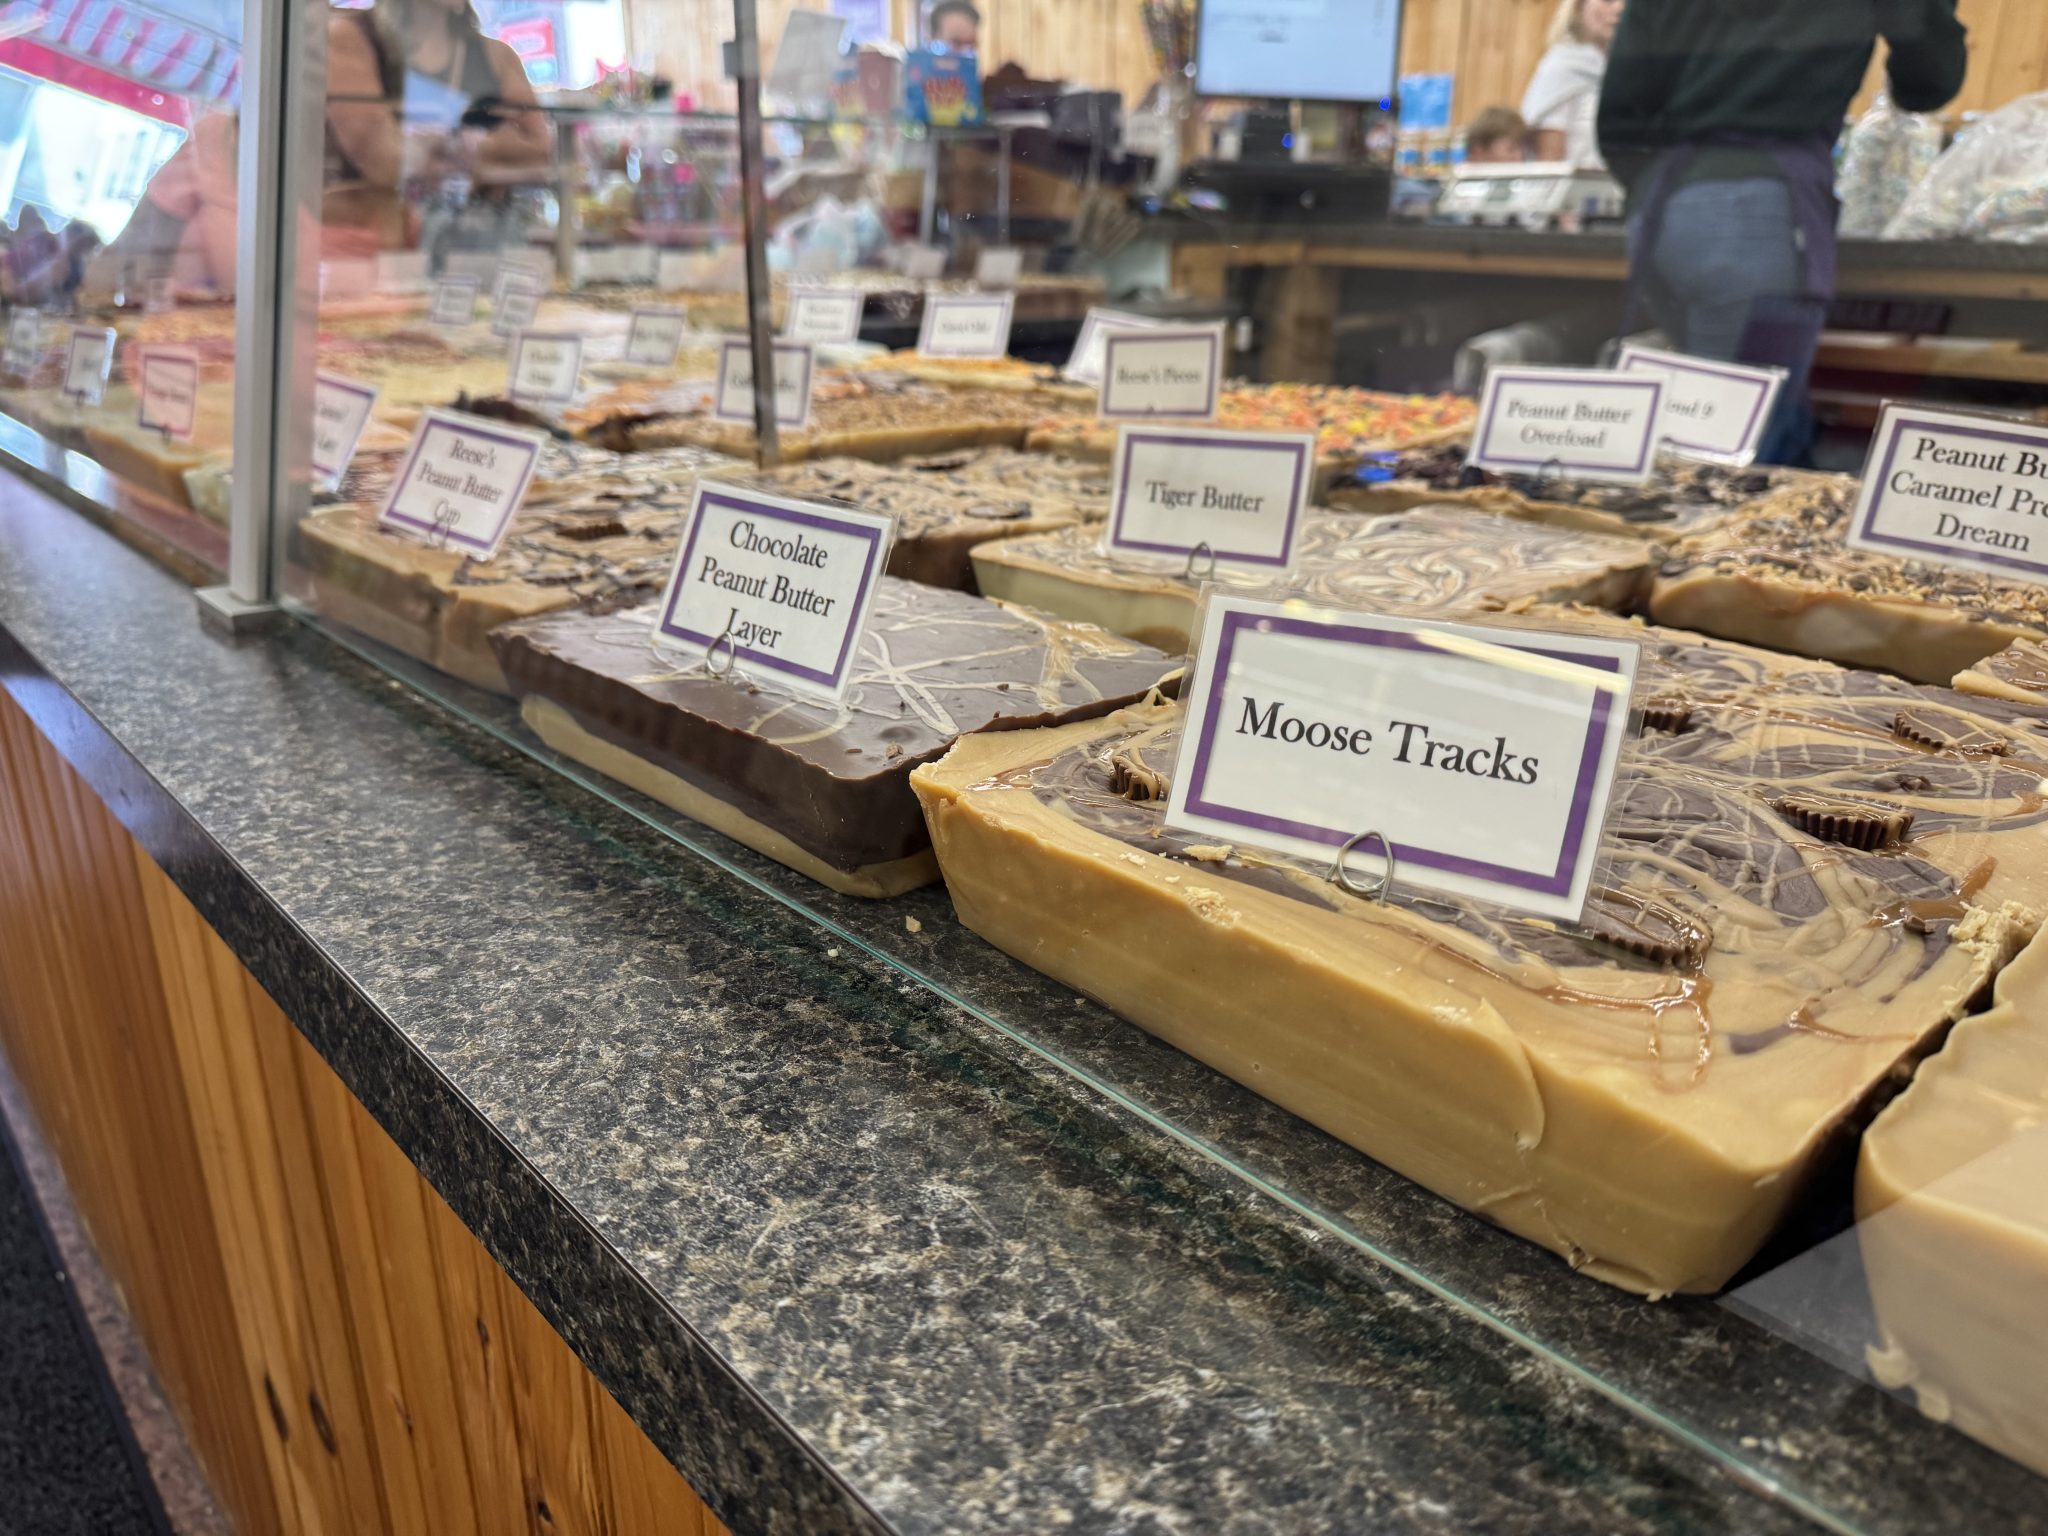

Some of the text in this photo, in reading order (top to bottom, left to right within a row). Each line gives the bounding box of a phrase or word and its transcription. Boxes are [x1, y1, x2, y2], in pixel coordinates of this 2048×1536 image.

[1506, 399, 1633, 425] Peanut Butter
[449, 437, 497, 470] Reese's
[1520, 426, 1606, 449] Overload
[1912, 437, 2008, 473] Peanut
[415, 459, 505, 504] Peanut Butter
[1145, 479, 1264, 513] Tiger Butter
[1890, 469, 2002, 509] Caramel
[730, 520, 828, 569] Chocolate
[1933, 512, 2030, 552] Dream
[698, 555, 835, 617] Peanut Butter
[725, 607, 782, 648] Layer
[1235, 696, 1539, 785] Moose Tracks
